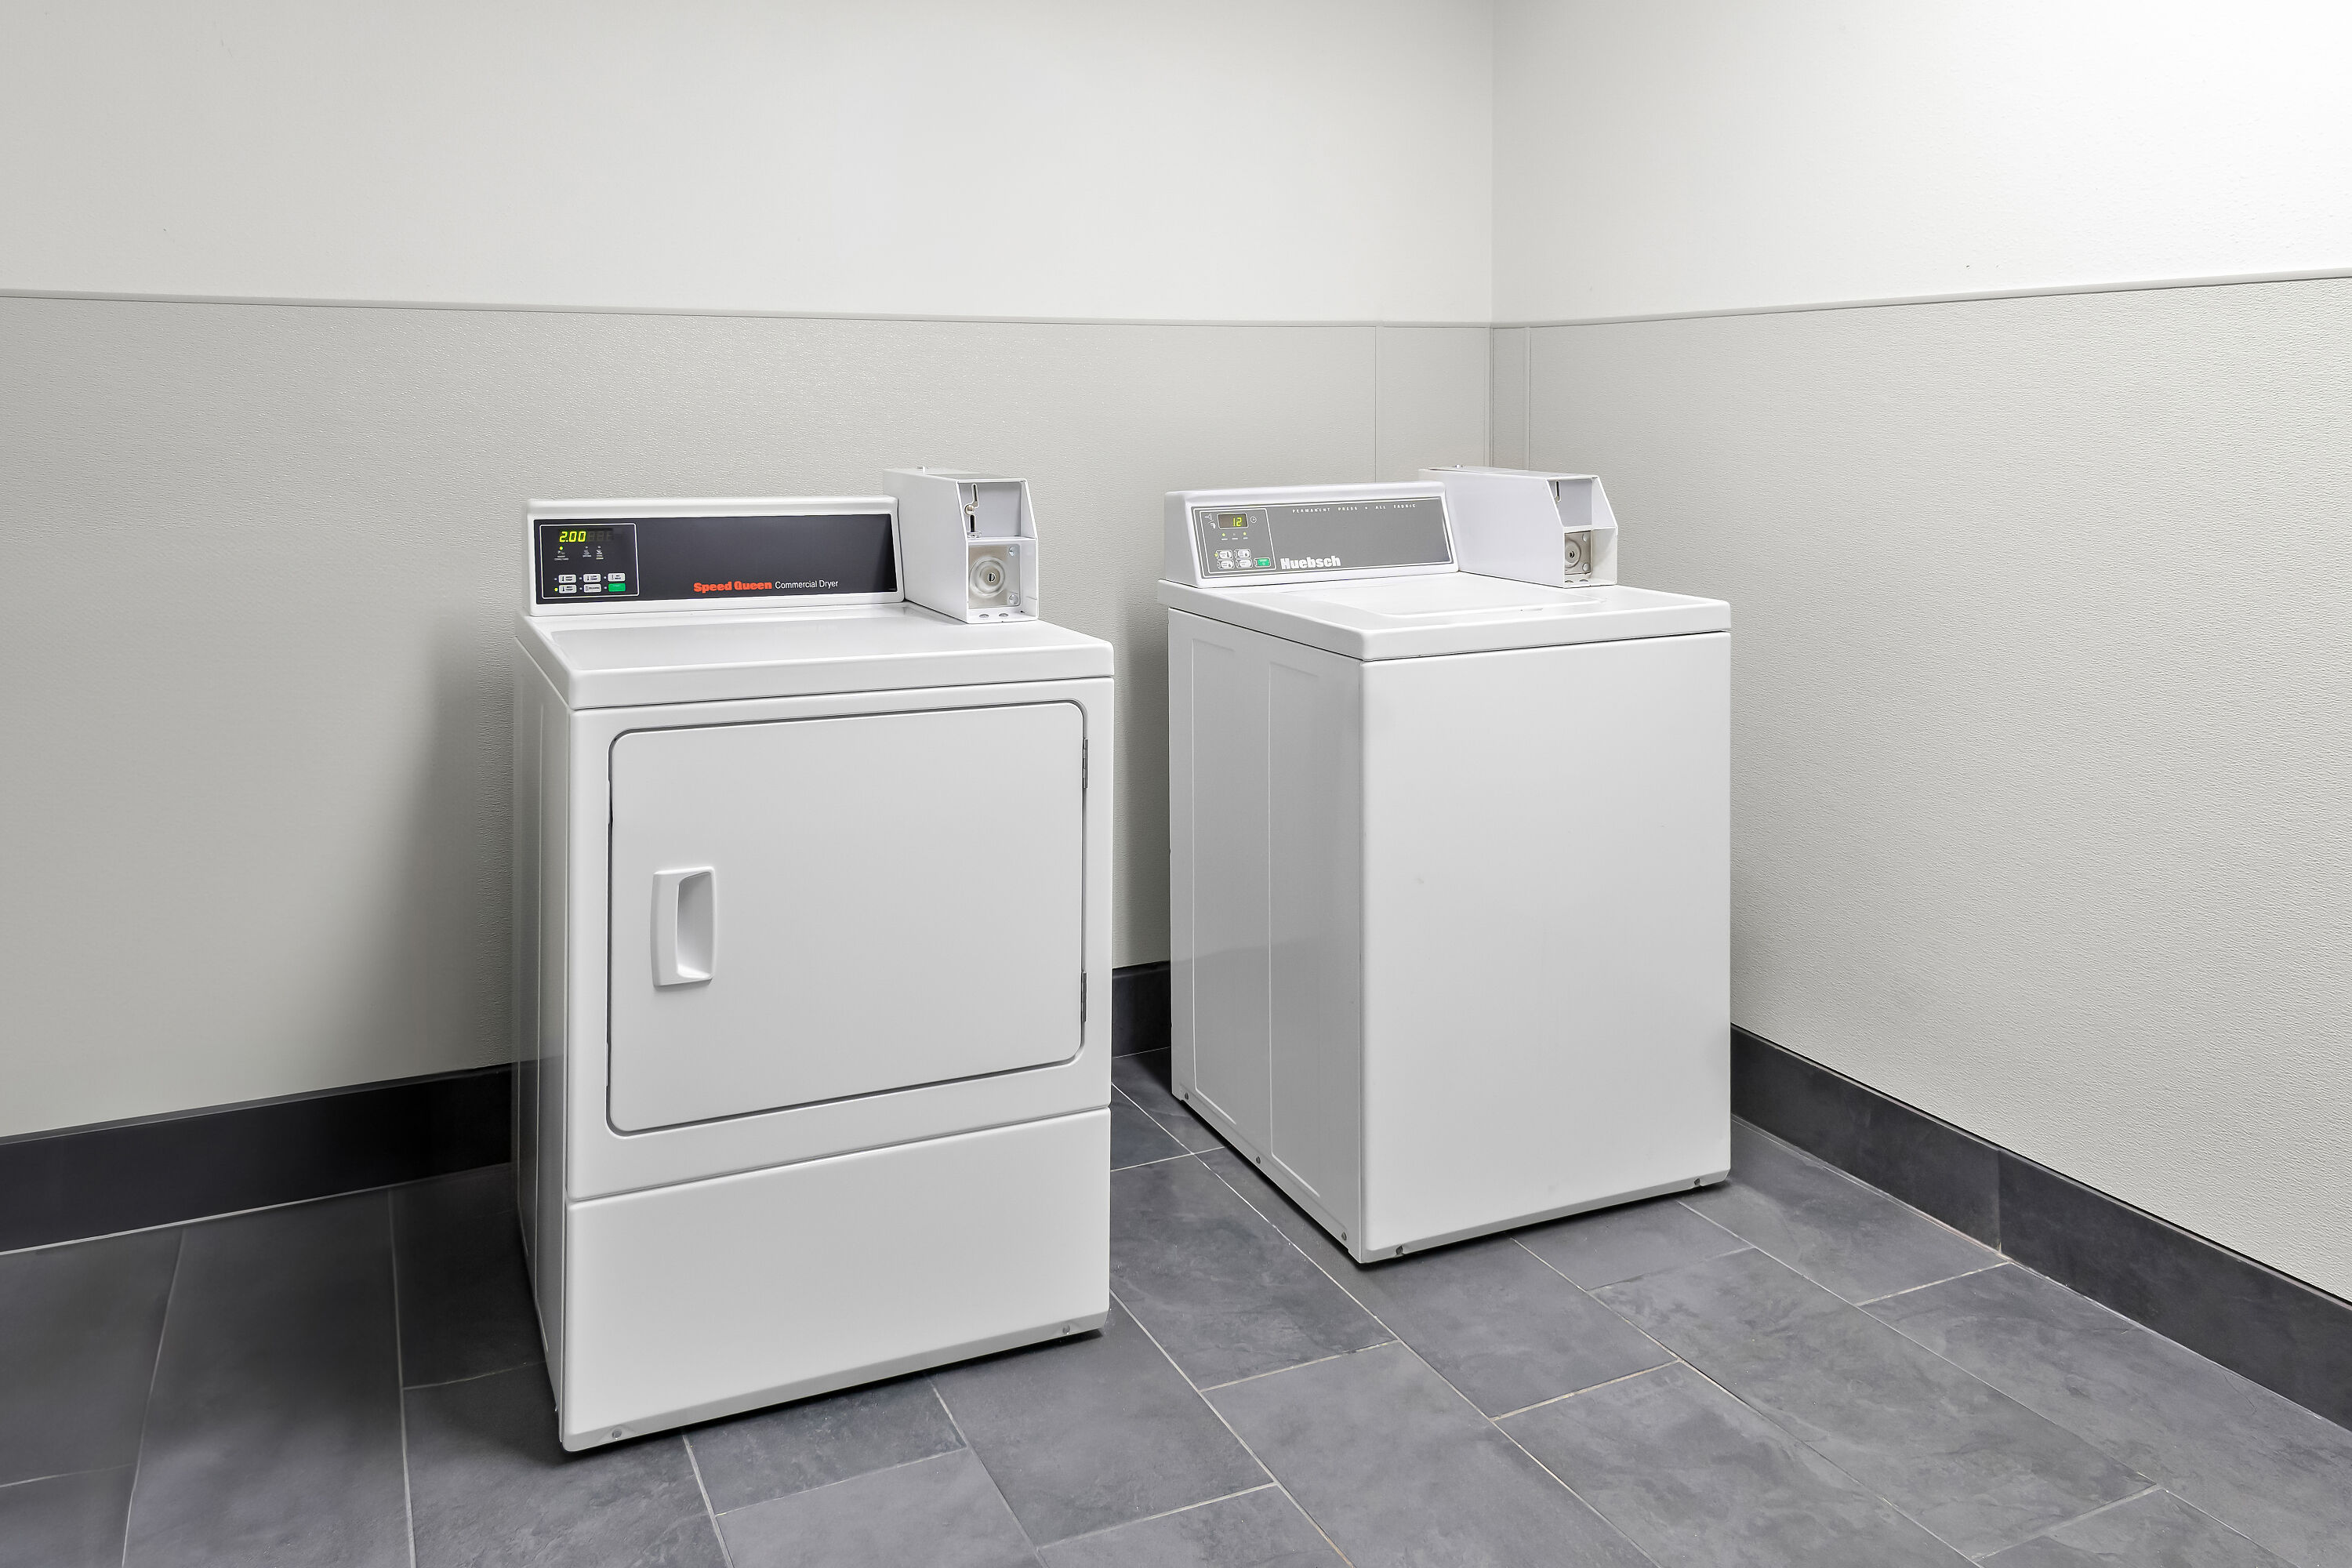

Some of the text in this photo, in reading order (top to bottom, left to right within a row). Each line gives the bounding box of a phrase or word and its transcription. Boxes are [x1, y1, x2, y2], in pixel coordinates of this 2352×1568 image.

[1232, 517, 1242, 527] 12
[559, 531, 586, 543] 2.00
[1279, 555, 1341, 570] Huebsch
[693, 579, 839, 593] Speed Queen Commercial Dryer
